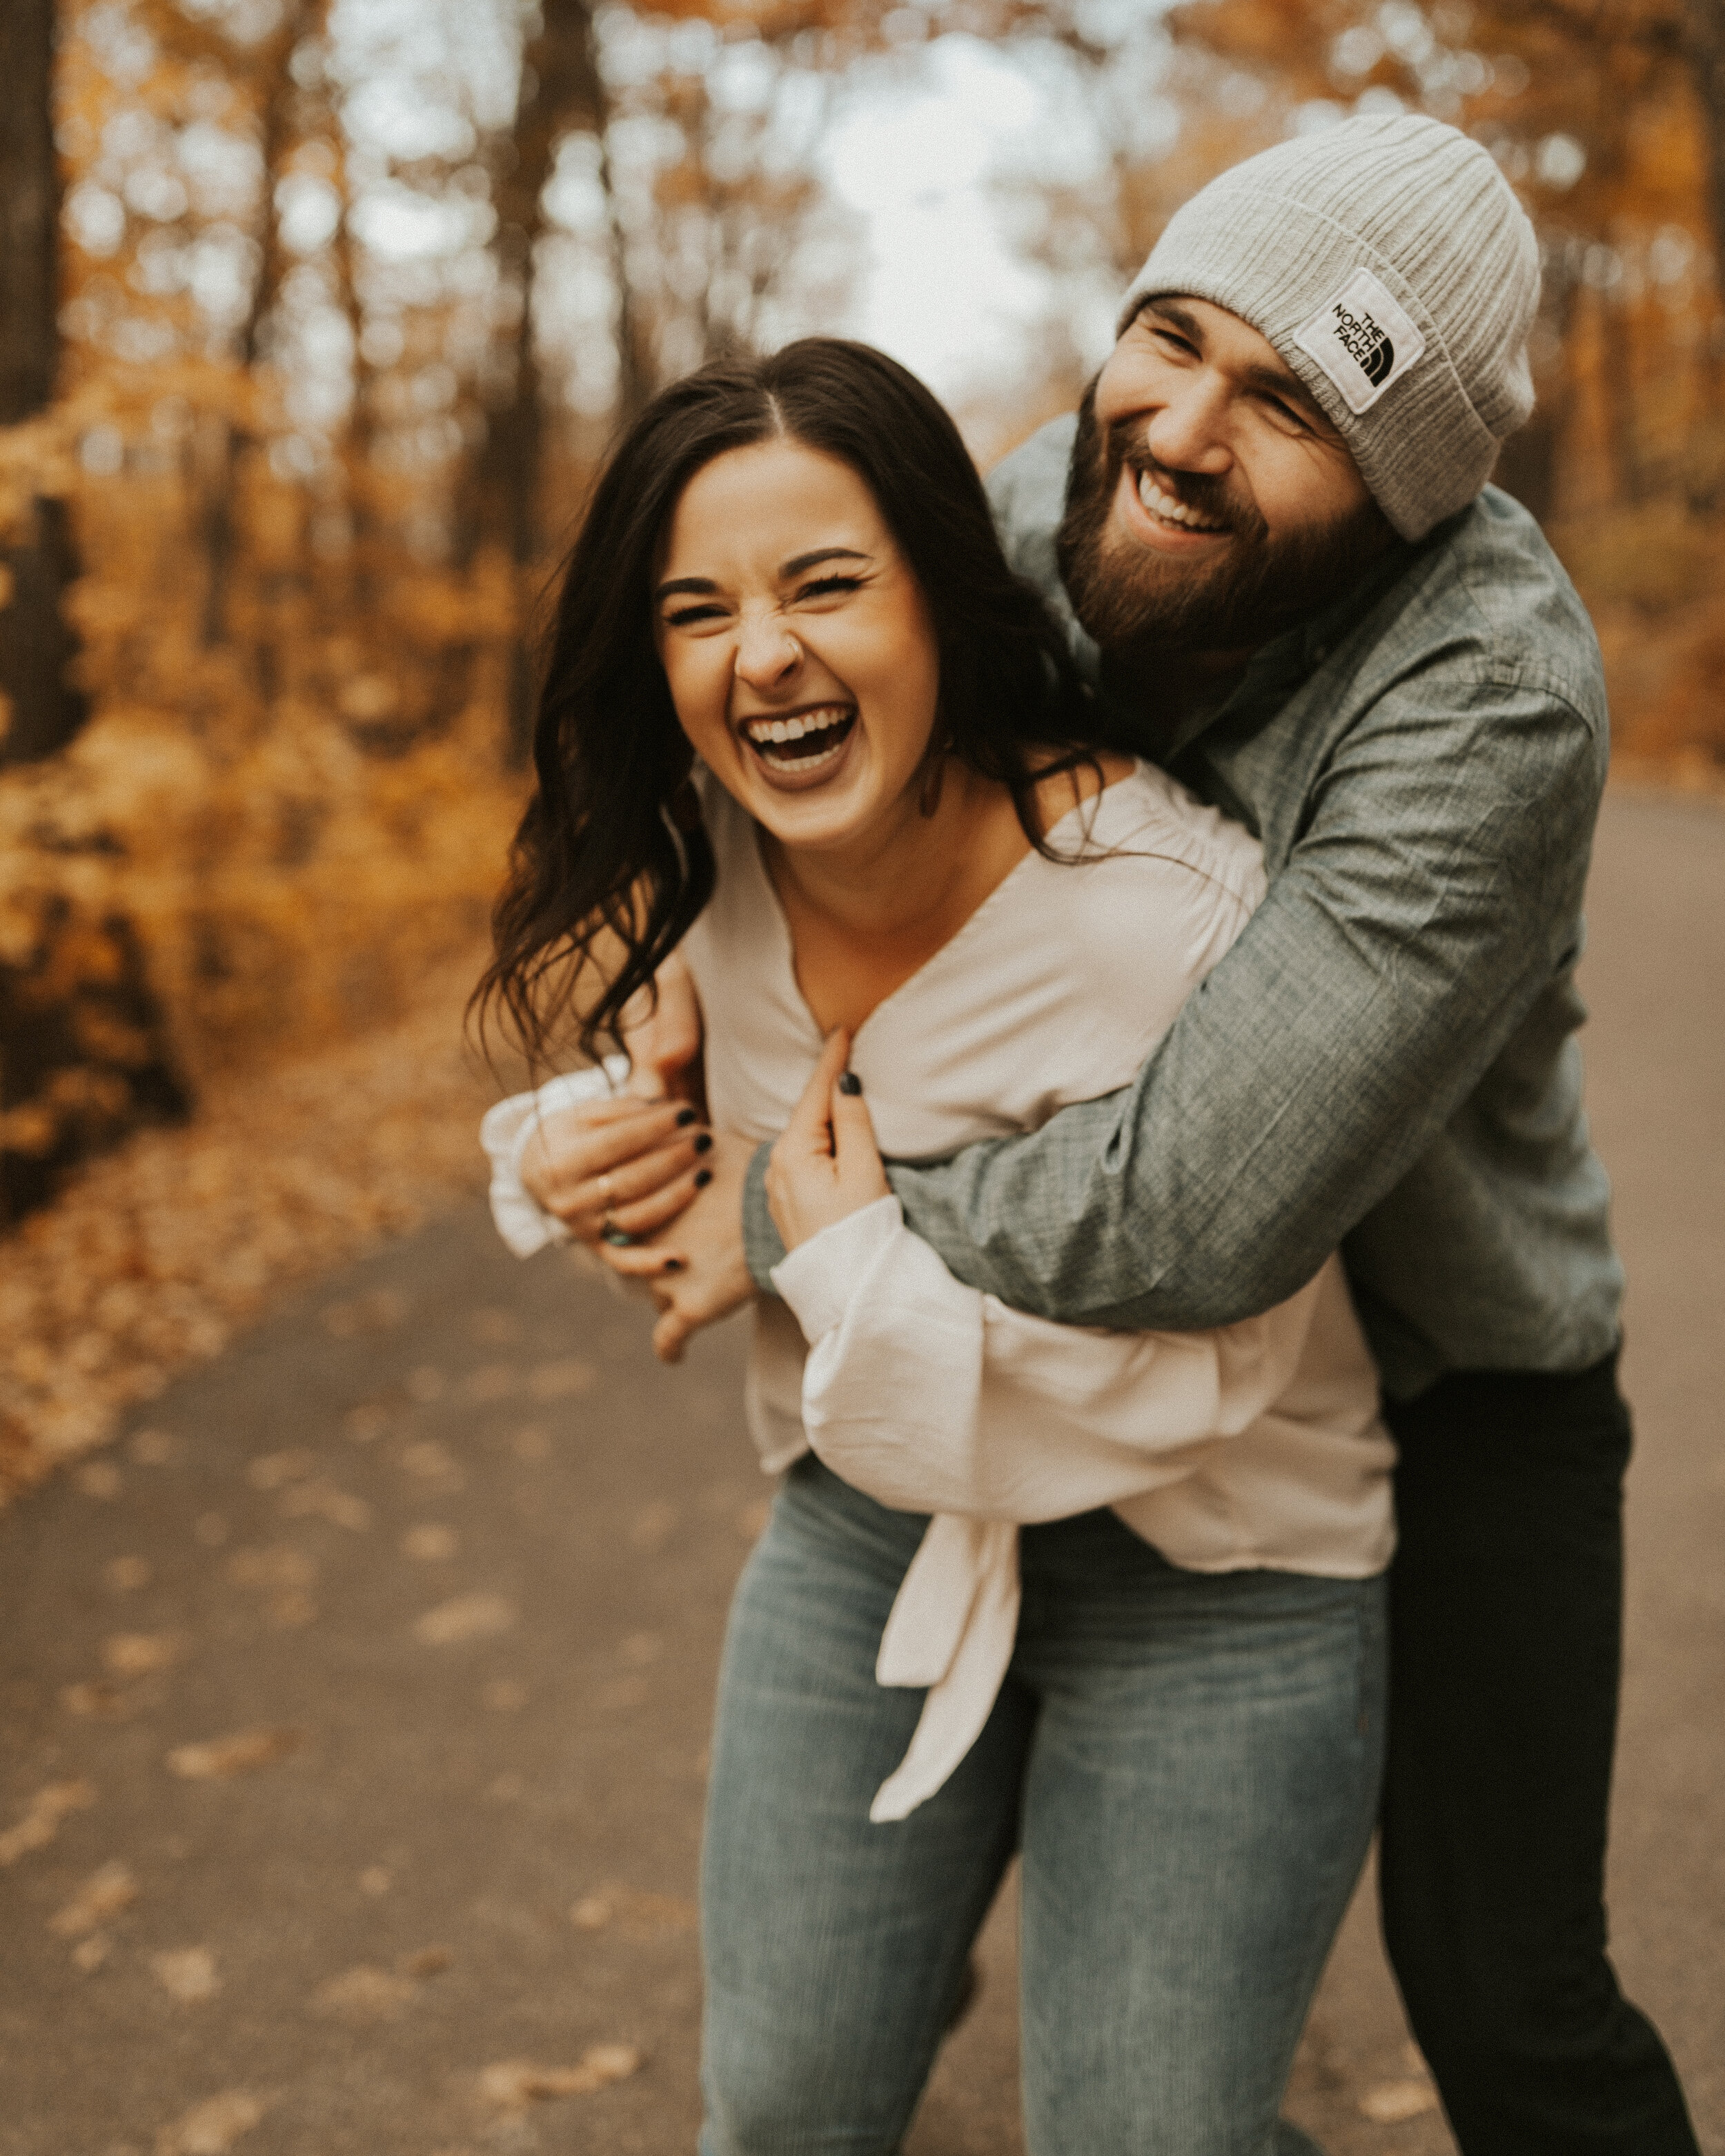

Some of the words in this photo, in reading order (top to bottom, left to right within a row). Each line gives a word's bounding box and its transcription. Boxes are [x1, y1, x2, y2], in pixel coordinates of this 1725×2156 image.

[1332, 303, 1376, 353] NORTH
[1333, 326, 1366, 362] FACE
[1361, 313, 1385, 342] THE
